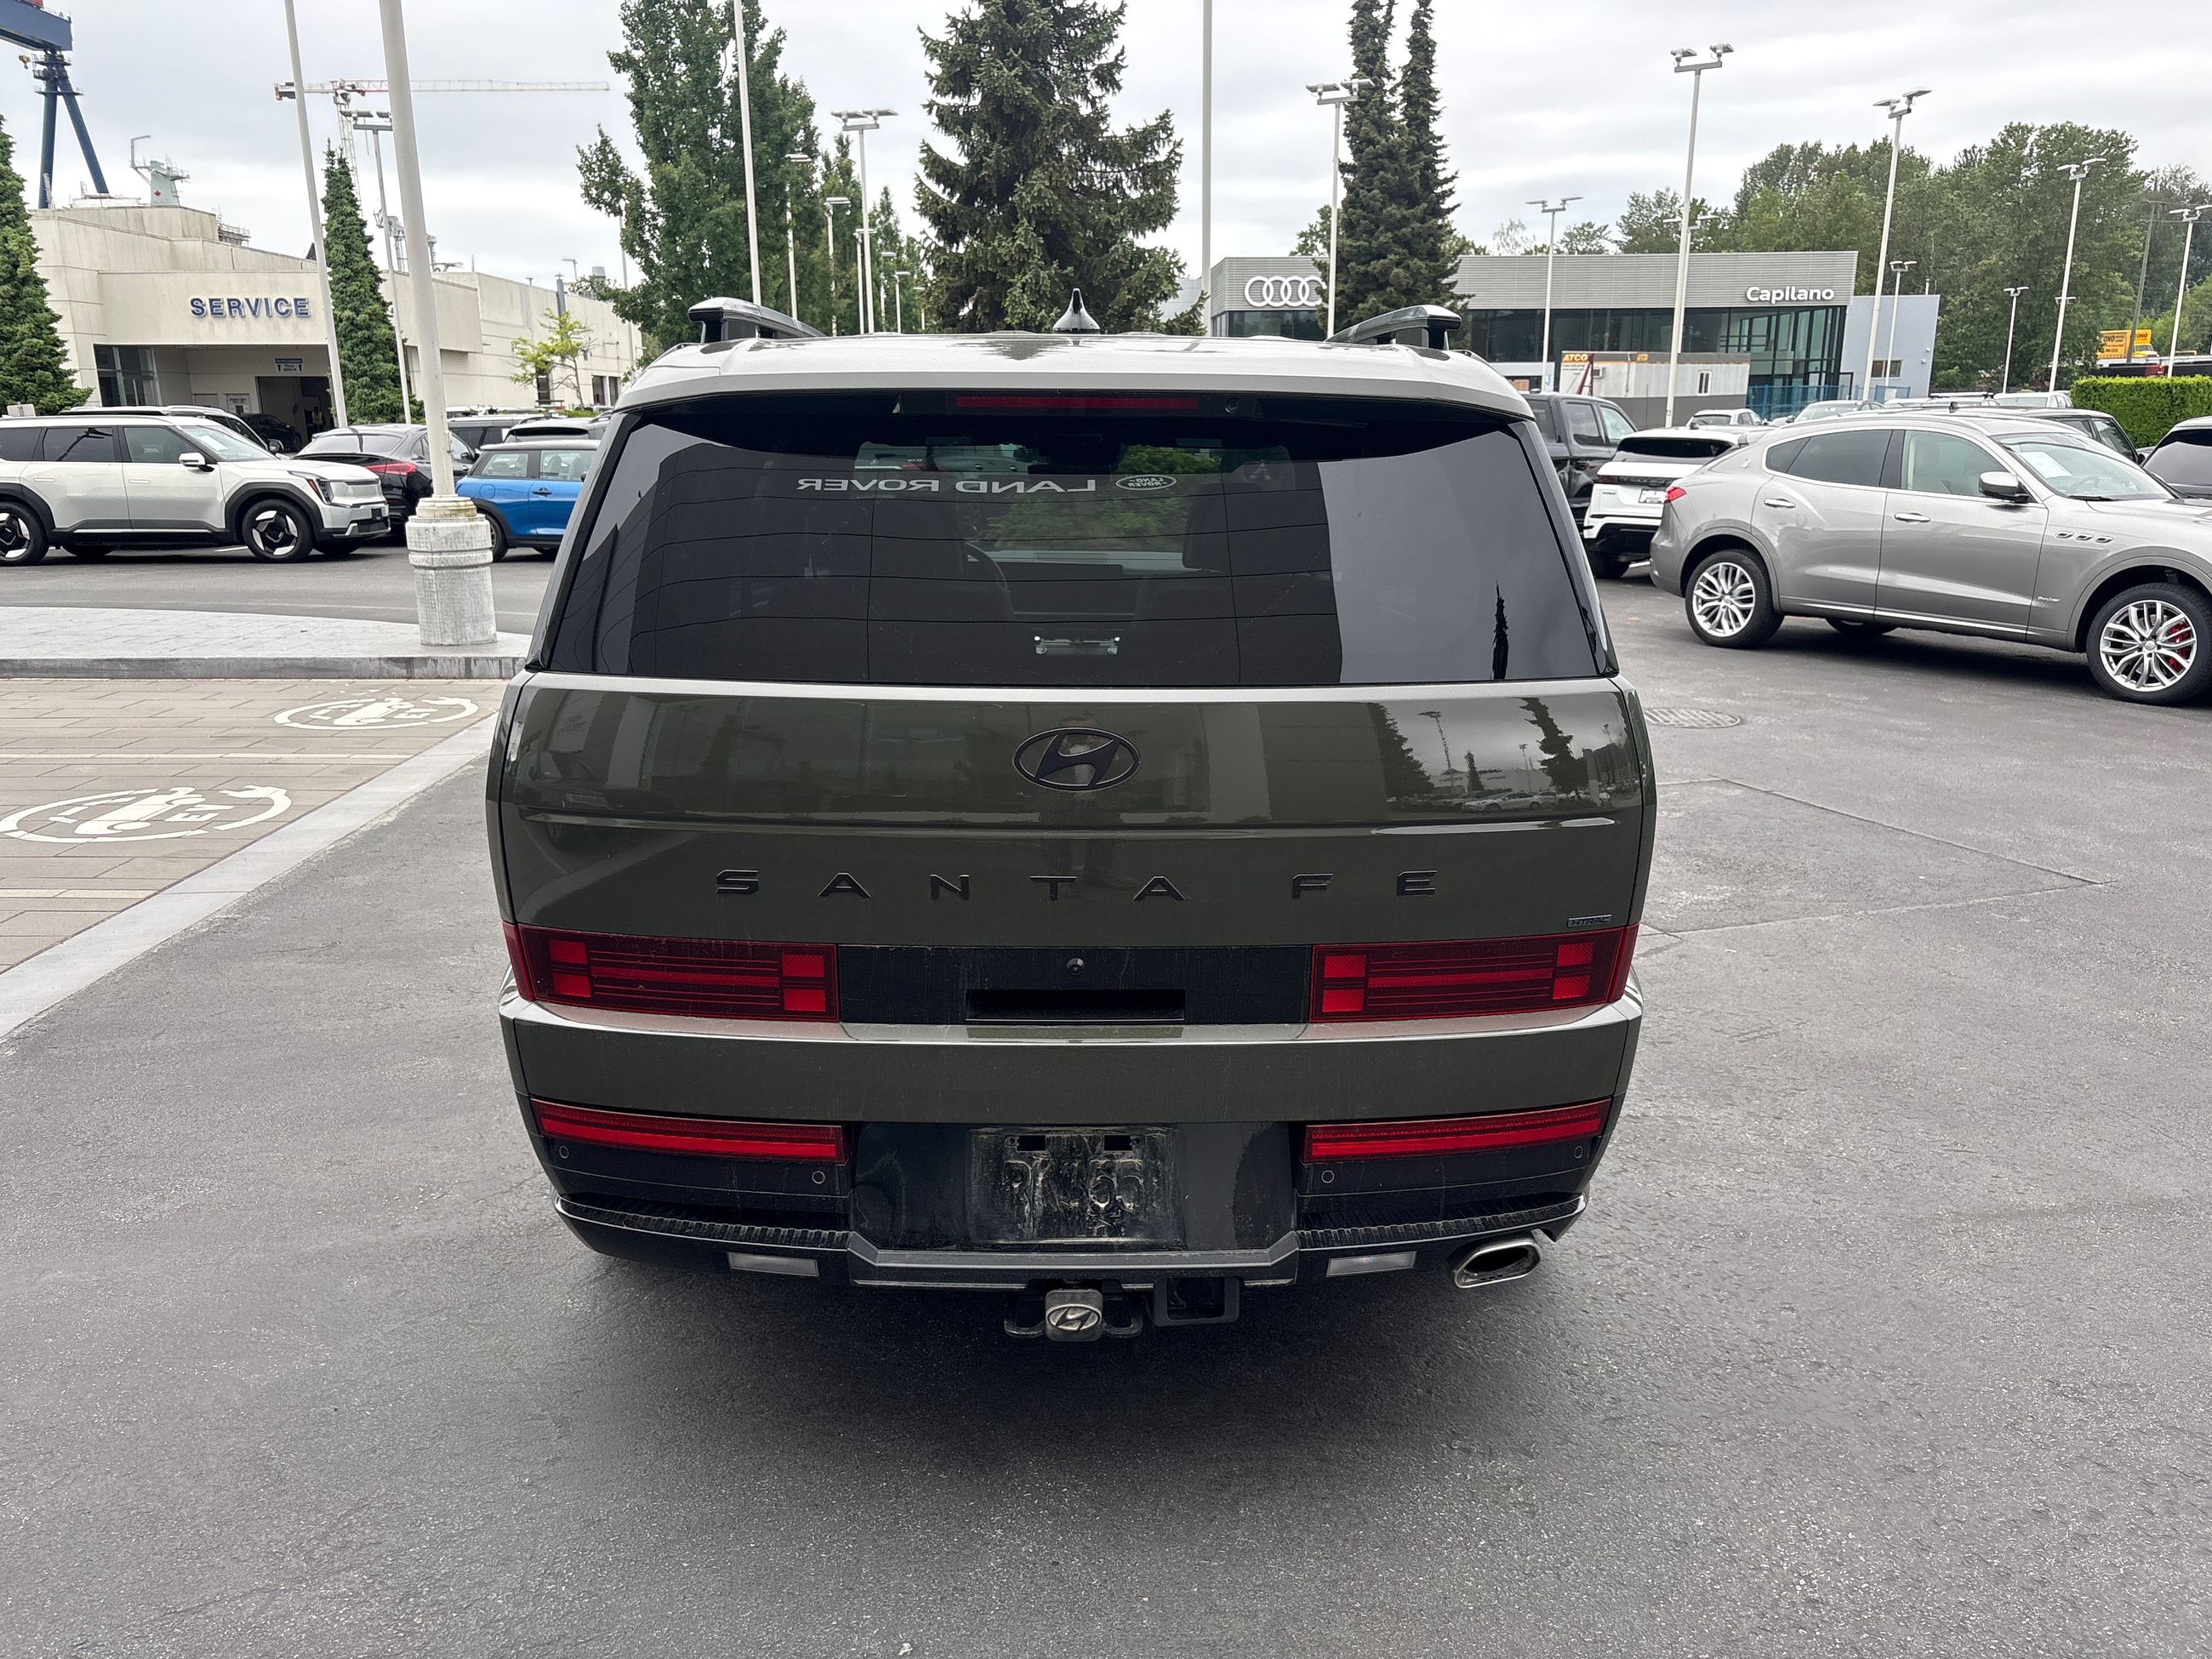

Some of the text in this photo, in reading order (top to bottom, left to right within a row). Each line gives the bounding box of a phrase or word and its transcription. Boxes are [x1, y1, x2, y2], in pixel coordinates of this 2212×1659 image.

[1747, 286, 1834, 305] Capilano
[190, 297, 311, 318] SERVICE
[1562, 353, 1588, 362] ATCO
[164, 804, 235, 821] EV
[716, 869, 1438, 901] SANTA FE
[1571, 917, 1610, 926] HTRAC
